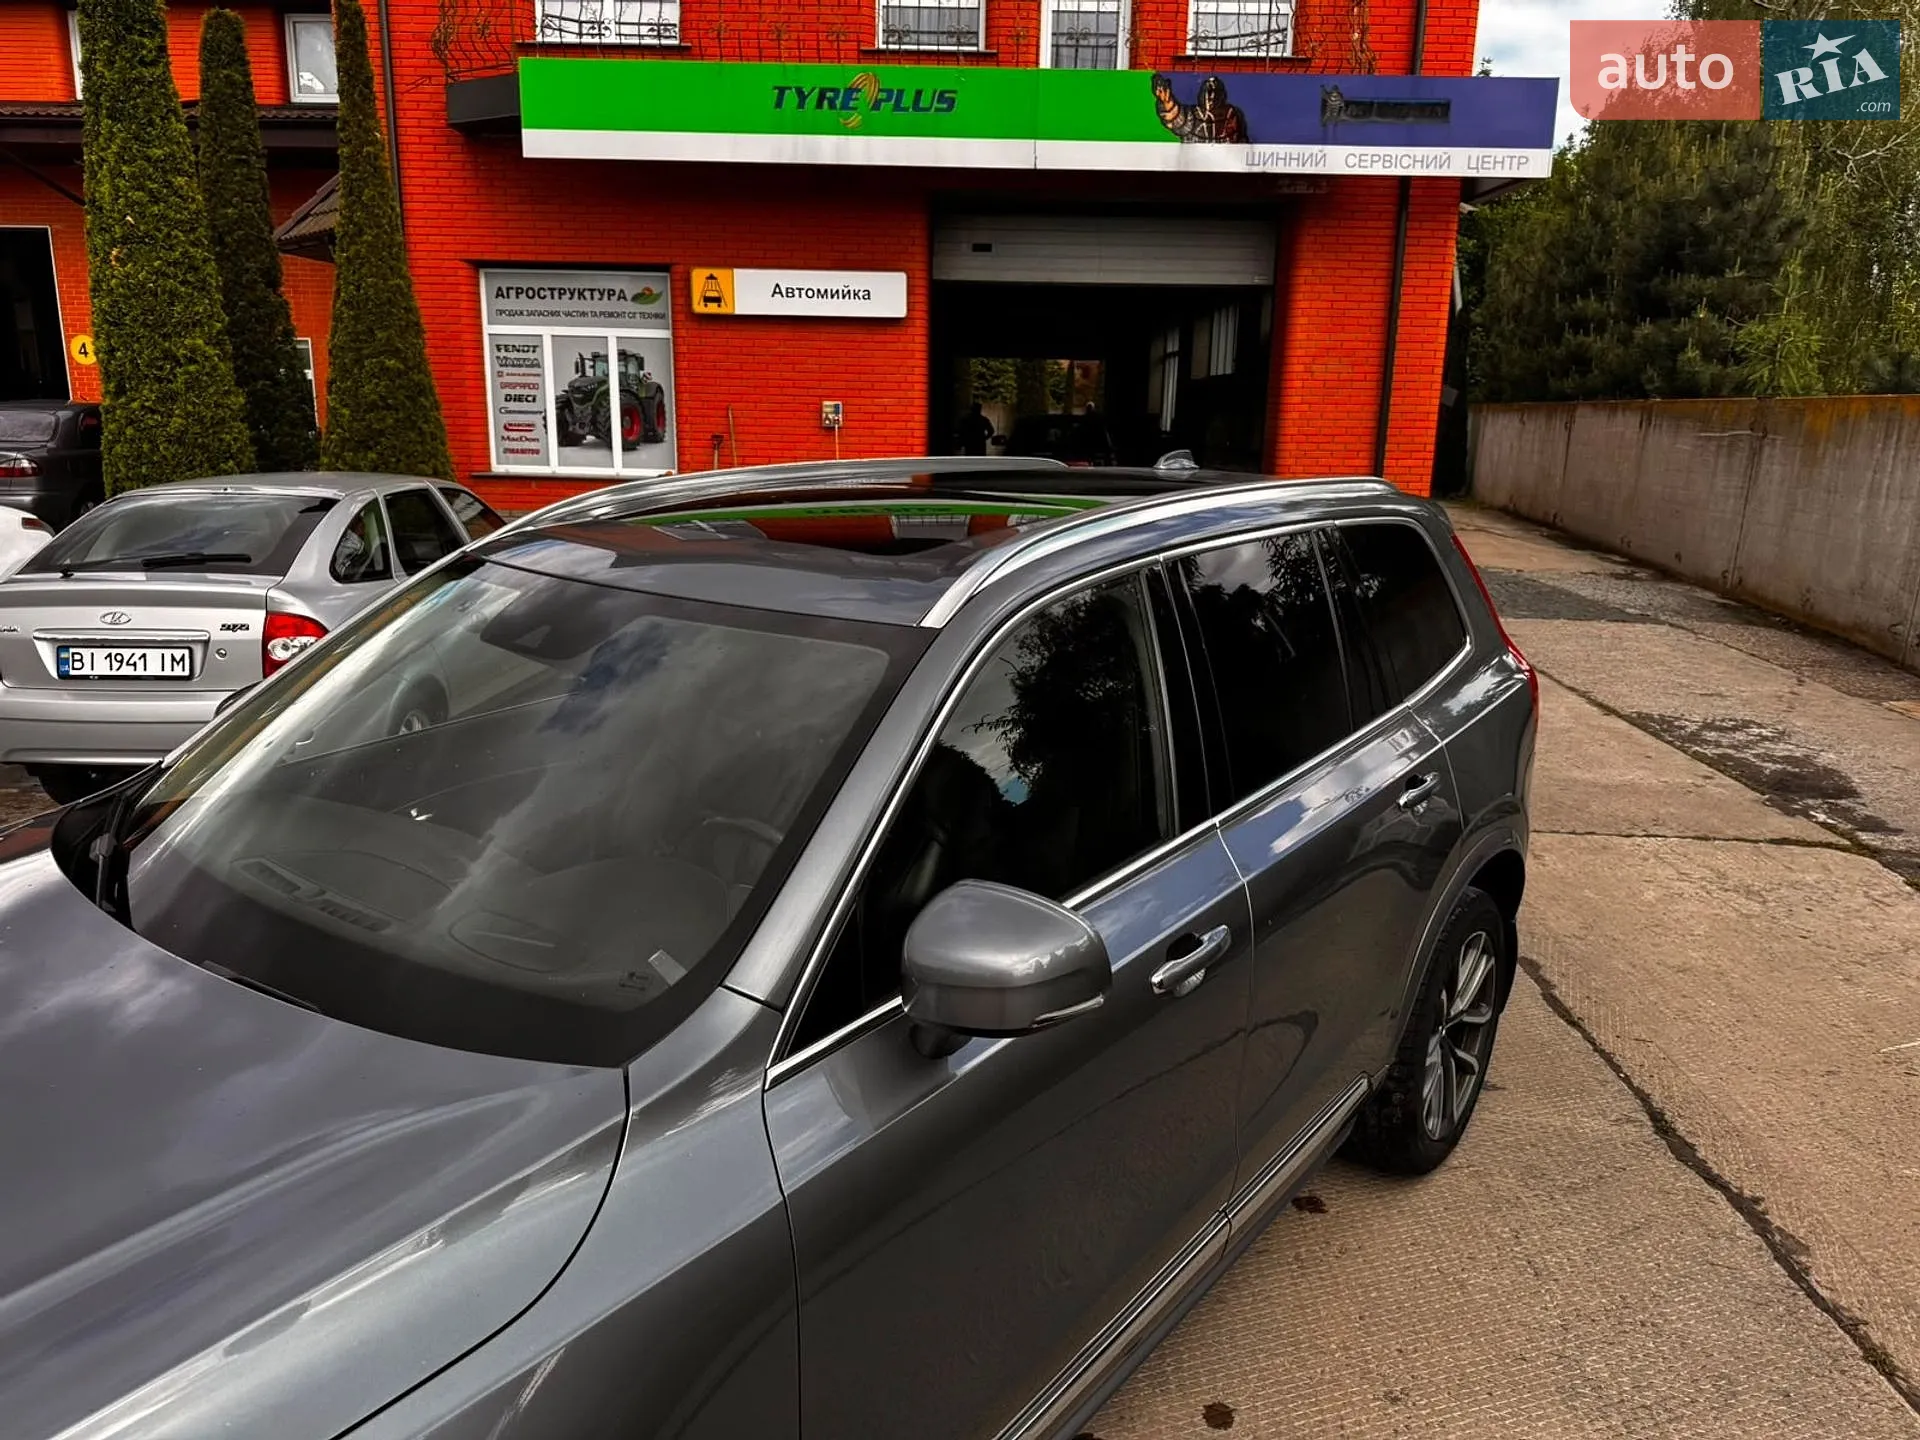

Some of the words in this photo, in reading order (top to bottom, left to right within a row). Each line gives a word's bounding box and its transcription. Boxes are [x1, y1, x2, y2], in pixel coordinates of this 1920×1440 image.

[772, 85, 863, 112] TYRE
[869, 88, 959, 114] PLUS
[1245, 149, 1327, 169] ШИННИЙ
[1344, 151, 1451, 170] СЕРВІСНИЙ
[1466, 155, 1529, 174] ЦЕНТР
[495, 286, 629, 302] АГРОСТРУКТУРА
[770, 282, 872, 301] Автомийка
[495, 309, 525, 317] ПРОДАЖ
[78, 342, 89, 358] 4
[495, 344, 539, 353] FENDT
[504, 394, 537, 403] DIECI
[71, 652, 94, 671] BI
[104, 652, 147, 671] 1941
[161, 653, 185, 672] IM
